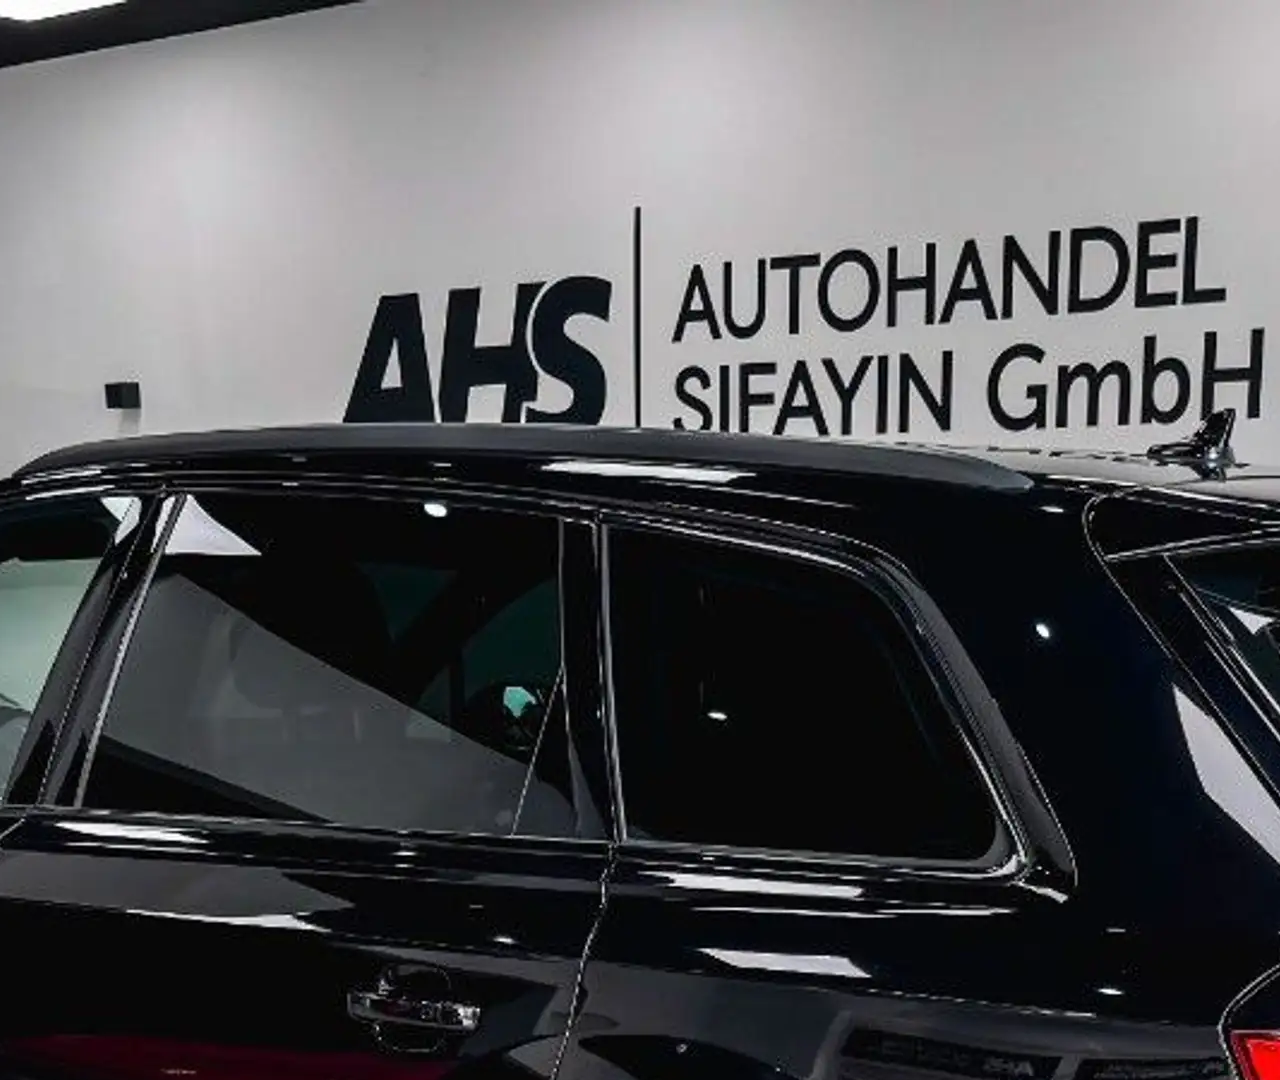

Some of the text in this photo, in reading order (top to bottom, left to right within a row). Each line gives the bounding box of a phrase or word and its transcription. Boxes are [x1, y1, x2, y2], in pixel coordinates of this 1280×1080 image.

[672, 216, 1227, 344] AUTOHANDEL
[343, 275, 612, 424] AHS
[672, 328, 1265, 434] SIFAYIN GmbH
